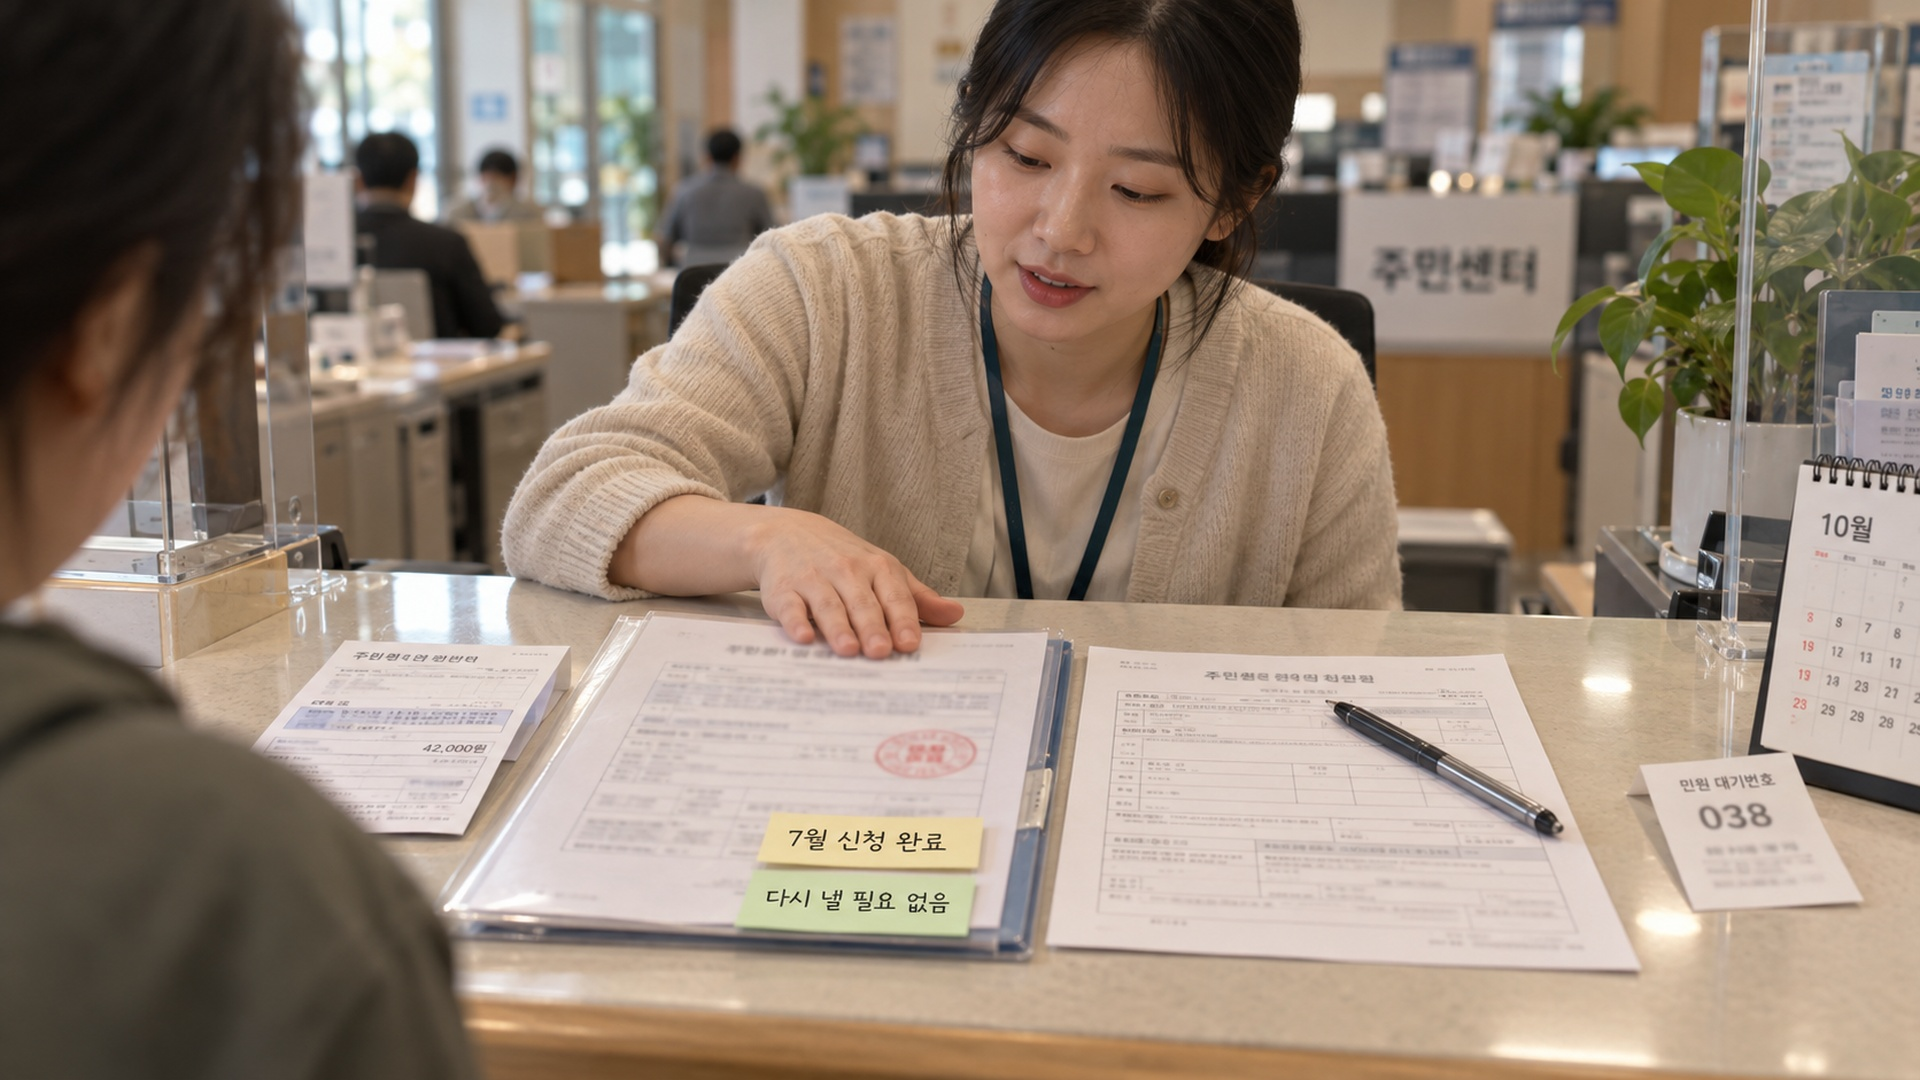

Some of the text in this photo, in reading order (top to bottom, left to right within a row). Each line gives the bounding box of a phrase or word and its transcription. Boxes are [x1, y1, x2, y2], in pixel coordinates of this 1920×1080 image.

[1822, 513, 1873, 544] 10월
[1864, 622, 1872, 634] 7
[422, 744, 488, 754] 42,000원
[1679, 772, 1776, 793] 민원 대기번호
[1698, 802, 1773, 830] 038
[788, 828, 947, 853] 7월 신청 완료
[766, 888, 950, 914] 다시 낼 필요 없음
